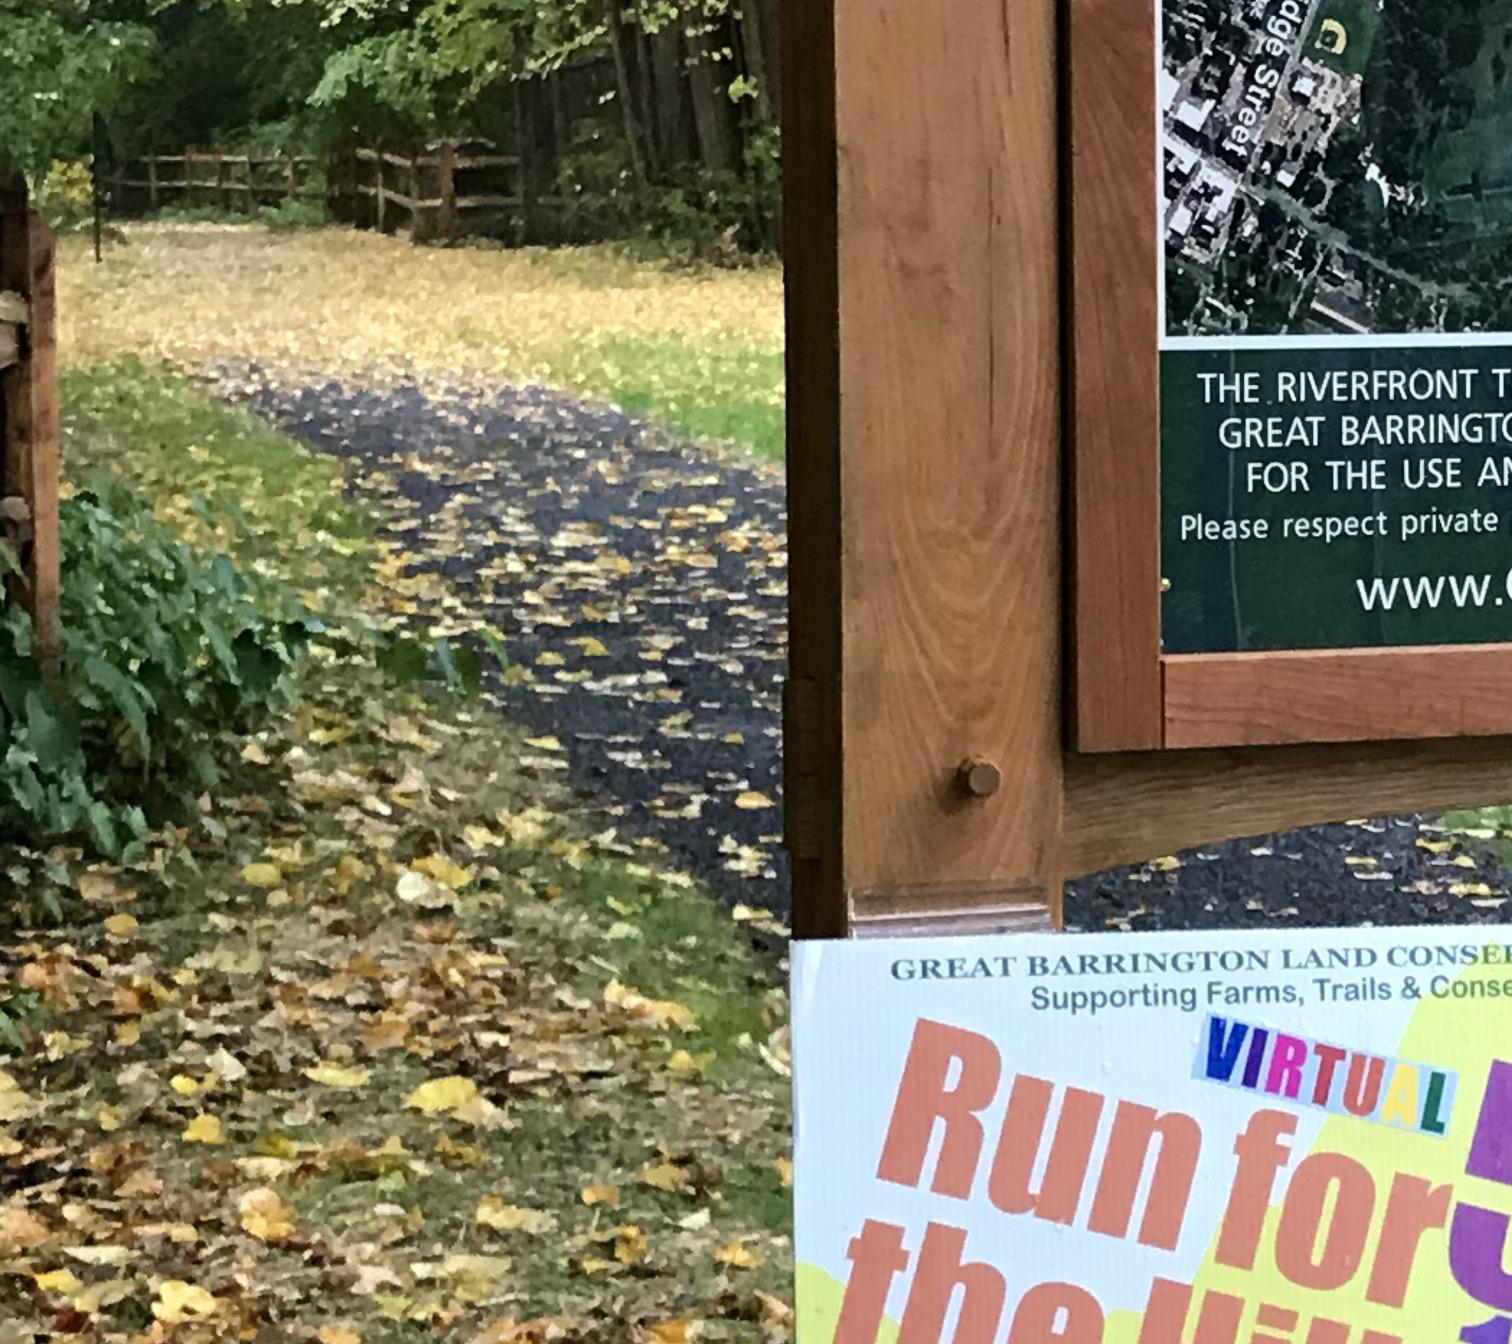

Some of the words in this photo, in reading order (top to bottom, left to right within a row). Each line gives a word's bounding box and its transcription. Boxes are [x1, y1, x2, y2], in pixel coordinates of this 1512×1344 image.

[1221, 64, 1280, 157] Street
[1197, 372, 1261, 404] THE
[1276, 368, 1479, 403] RIVERFRONT
[1218, 416, 1327, 449] GREAT
[1246, 461, 1310, 493] FOR
[1325, 459, 1388, 492] THE
[1403, 458, 1462, 489] USE
[1180, 513, 1269, 541] Please
[1282, 508, 1389, 544] respect
[1401, 505, 1499, 541] private
[890, 955, 1018, 984] GREAT
[1027, 947, 1270, 979] BARRINGTON
[1280, 945, 1378, 973] LAND
[1029, 978, 1197, 1017] Supporting
[1207, 976, 1305, 1010] Farms,
[1312, 973, 1392, 1003] Trails
[1400, 972, 1421, 1001] &
[1203, 1014, 1449, 1135] VIRTUAL
[876, 1016, 1202, 1251] Run
[1213, 1107, 1453, 1309] for
